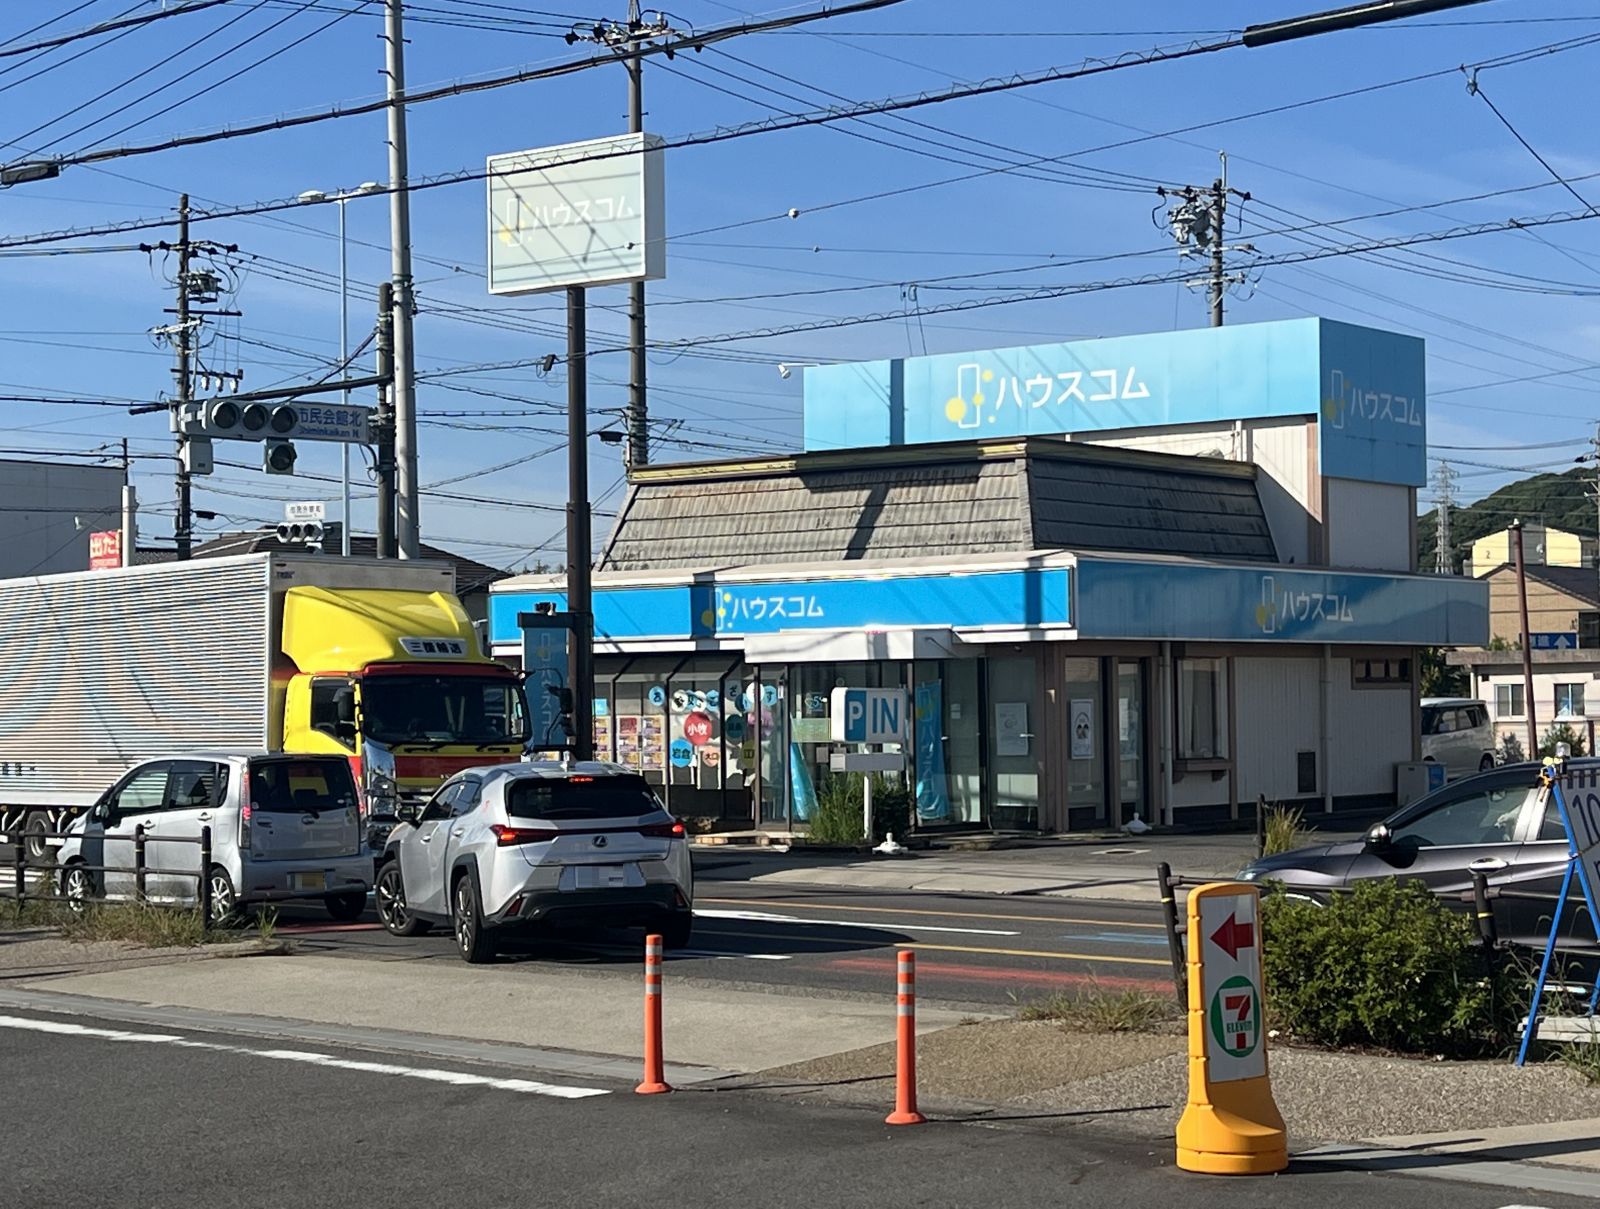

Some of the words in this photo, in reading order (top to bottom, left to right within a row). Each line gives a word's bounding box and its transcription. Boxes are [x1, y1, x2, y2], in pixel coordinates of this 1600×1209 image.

[534, 195, 634, 229] ハウスコム
[995, 366, 1151, 410] ハウスコム
[1349, 391, 1422, 427] ハウスコム
[732, 595, 824, 620] ハウスコム
[1281, 590, 1354, 623] ハウスコム
[687, 722, 708, 736] 小牧
[848, 701, 863, 730] P
[872, 697, 898, 734] IN
[672, 747, 690, 760] 岩倉
[1225, 994, 1251, 1050] 7
